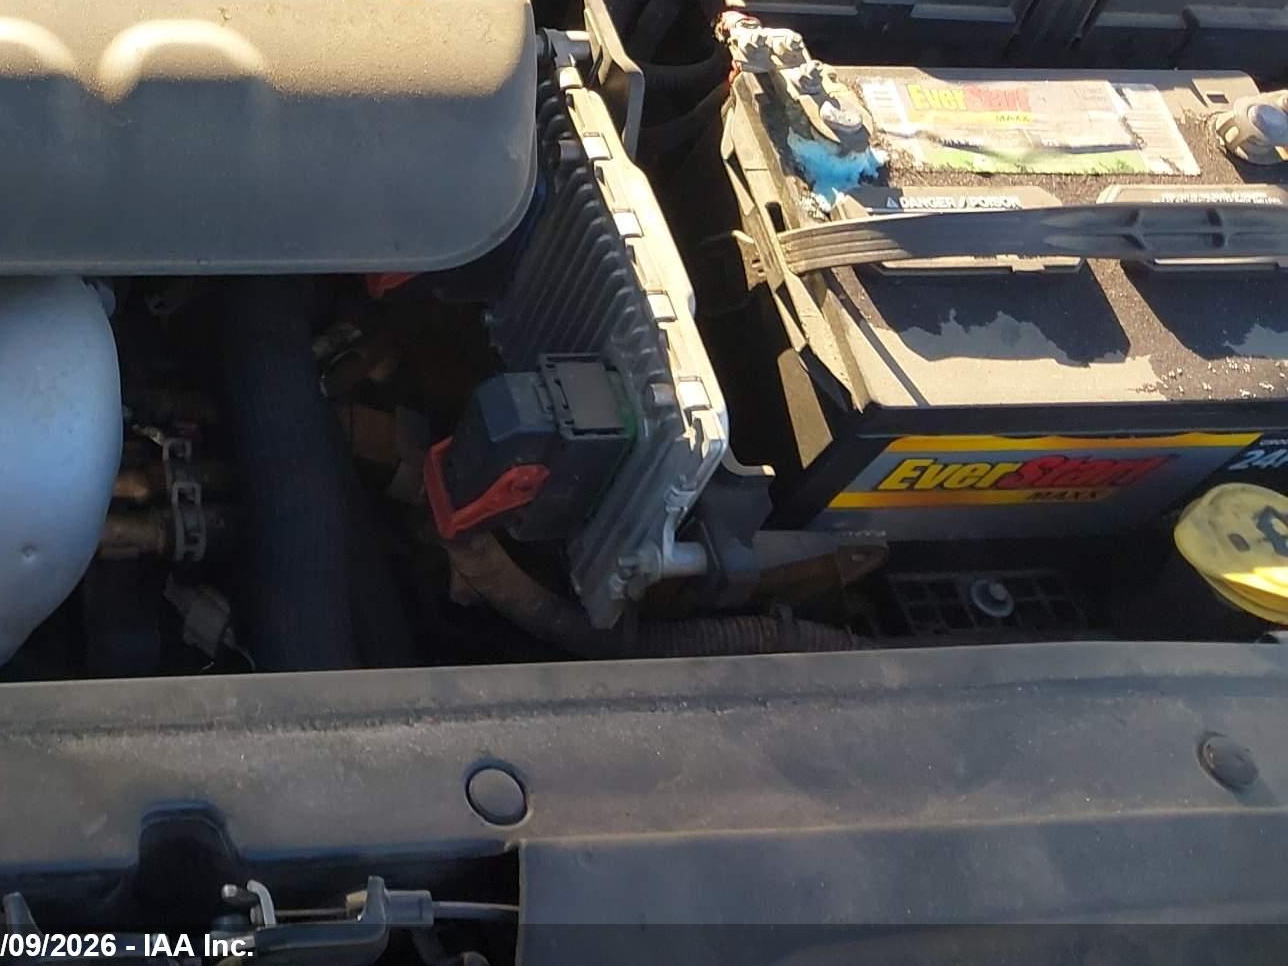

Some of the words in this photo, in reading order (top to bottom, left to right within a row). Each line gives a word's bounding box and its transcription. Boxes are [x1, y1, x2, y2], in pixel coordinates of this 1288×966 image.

[899, 196, 956, 209] DANGER
[969, 196, 1023, 209] POISON
[877, 455, 1175, 491] EverStart
